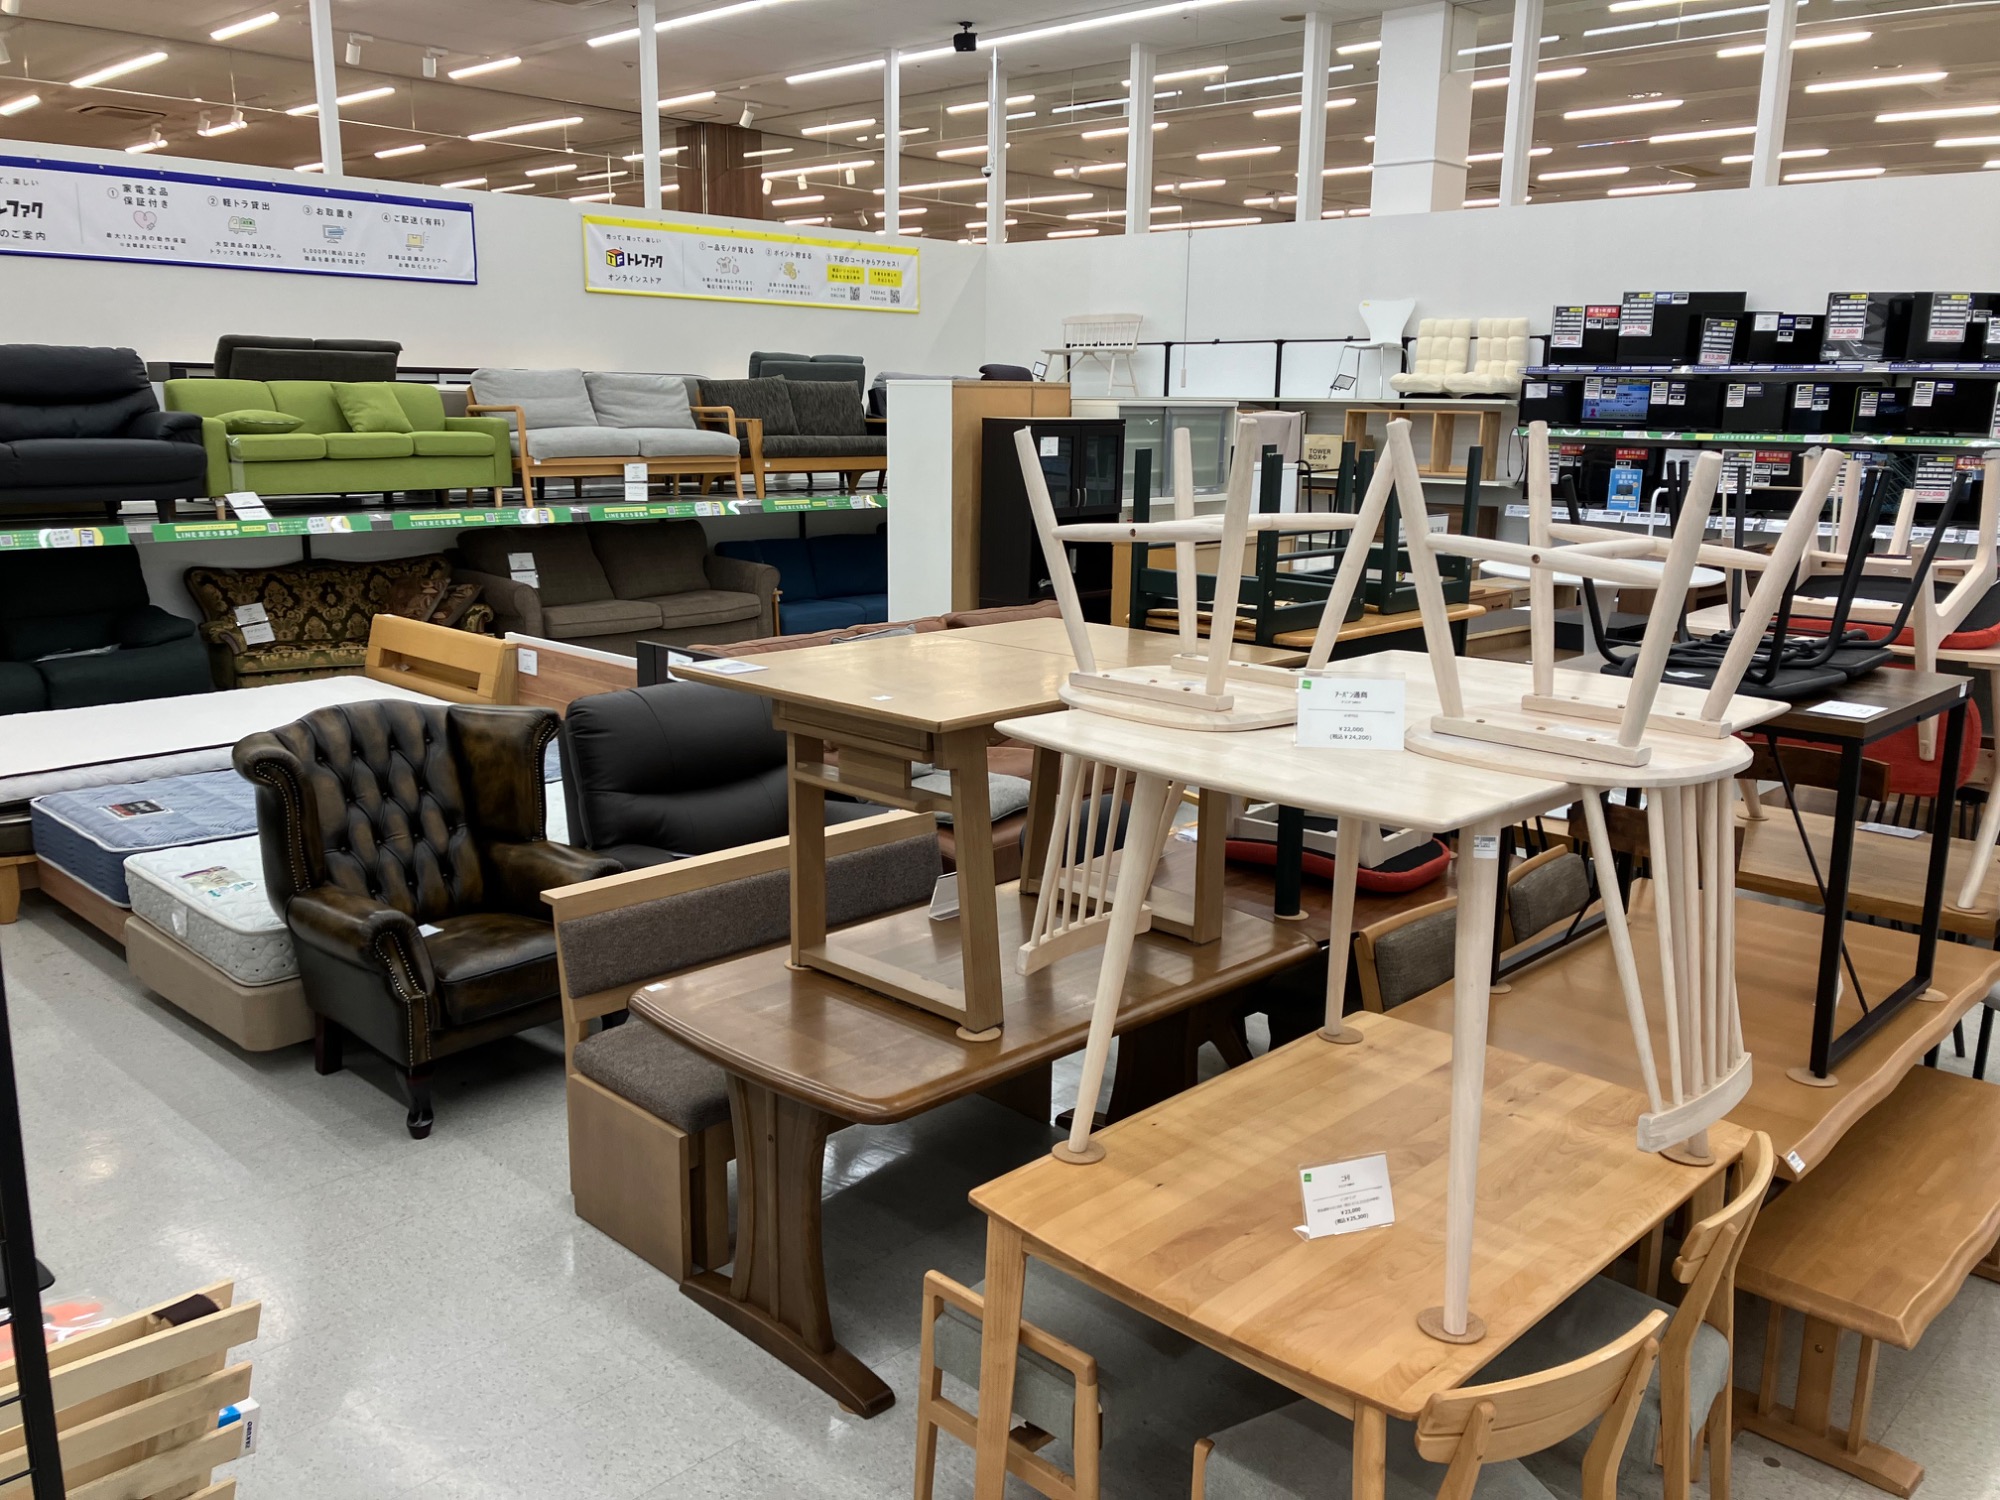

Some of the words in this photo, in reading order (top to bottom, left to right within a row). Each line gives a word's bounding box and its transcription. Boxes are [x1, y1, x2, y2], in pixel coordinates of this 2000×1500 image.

[122, 184, 169, 197] 家電全品
[123, 197, 169, 209] 保証付き
[222, 198, 270, 211] 軽トラ貸出
[316, 208, 353, 219] お取置き
[707, 243, 754, 254] 一品モノが買える
[774, 250, 812, 260] ポイント貯まる
[608, 274, 662, 284] オンラインストア
